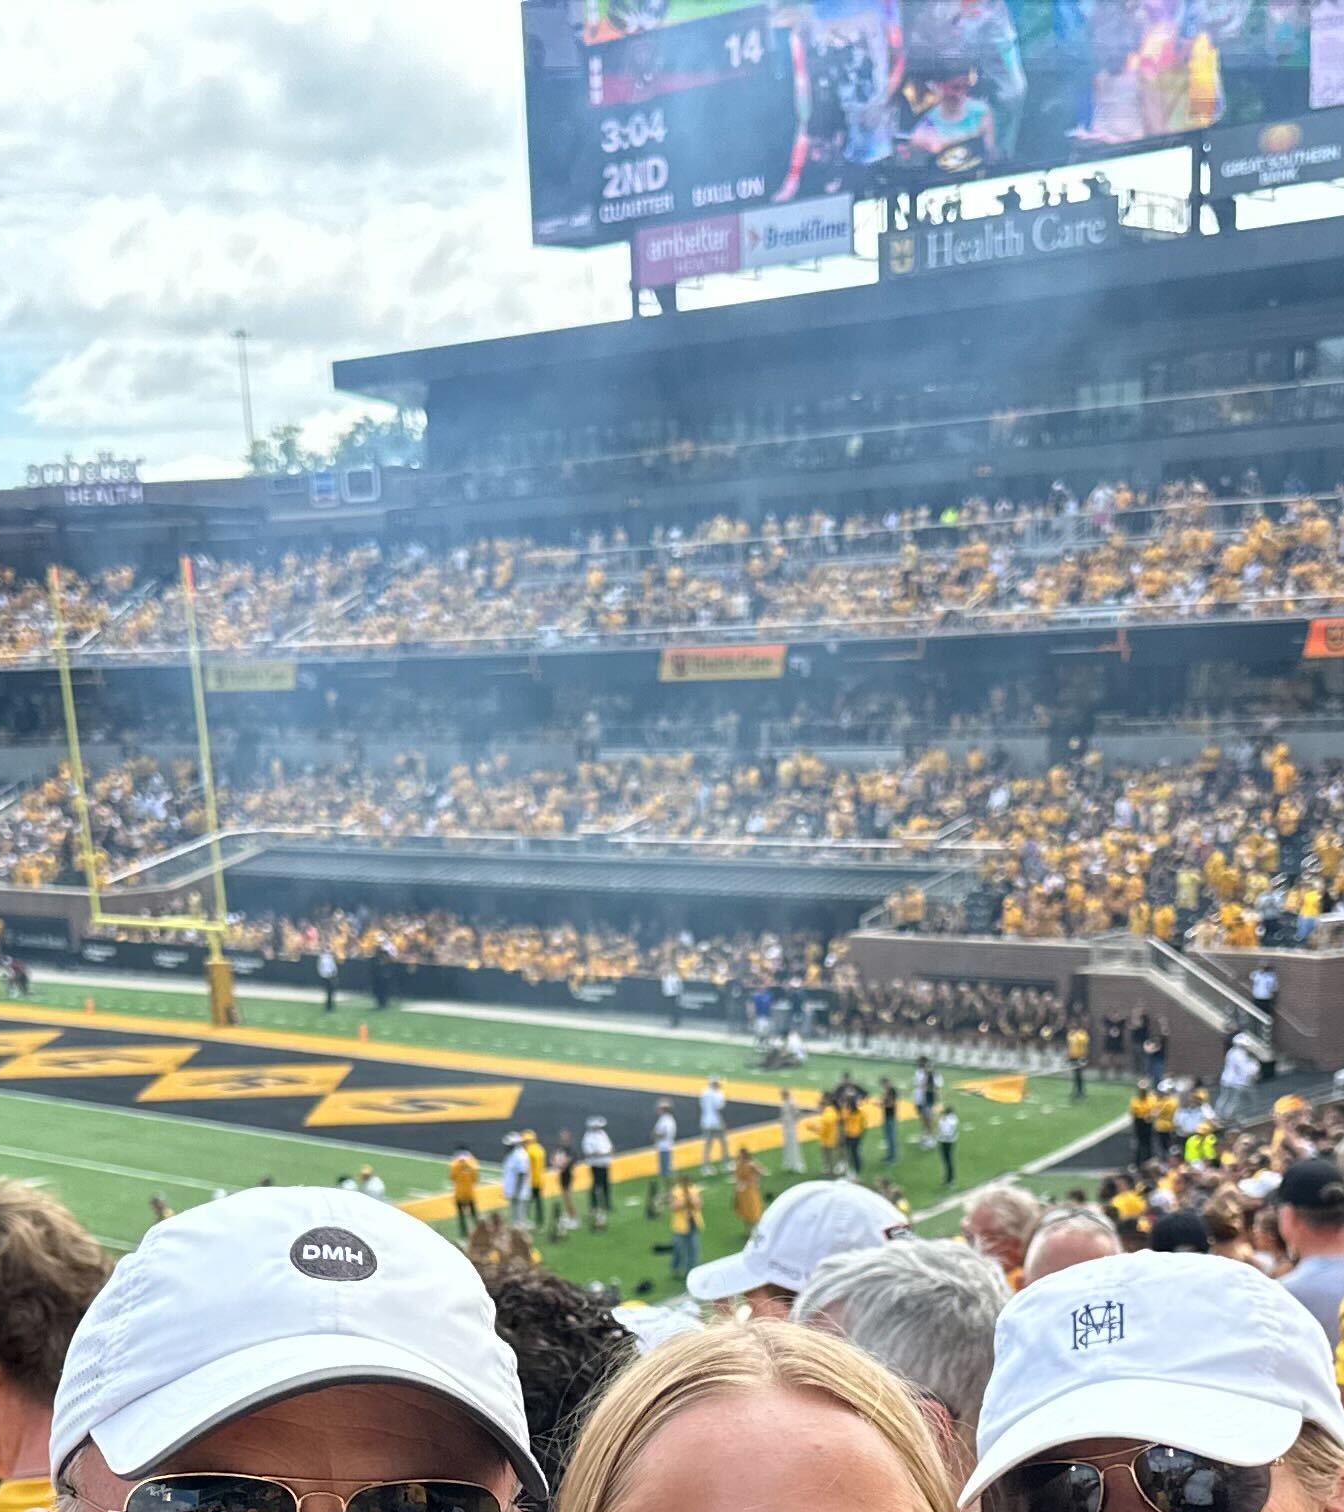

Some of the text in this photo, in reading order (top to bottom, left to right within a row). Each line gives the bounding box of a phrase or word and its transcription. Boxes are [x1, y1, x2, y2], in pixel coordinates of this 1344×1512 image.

[724, 29, 764, 67] 14
[601, 109, 667, 153] 3:04
[602, 154, 669, 199] 2ND
[927, 220, 1024, 269] Health
[1032, 212, 1107, 252] Care
[302, 1244, 364, 1266] DMH
